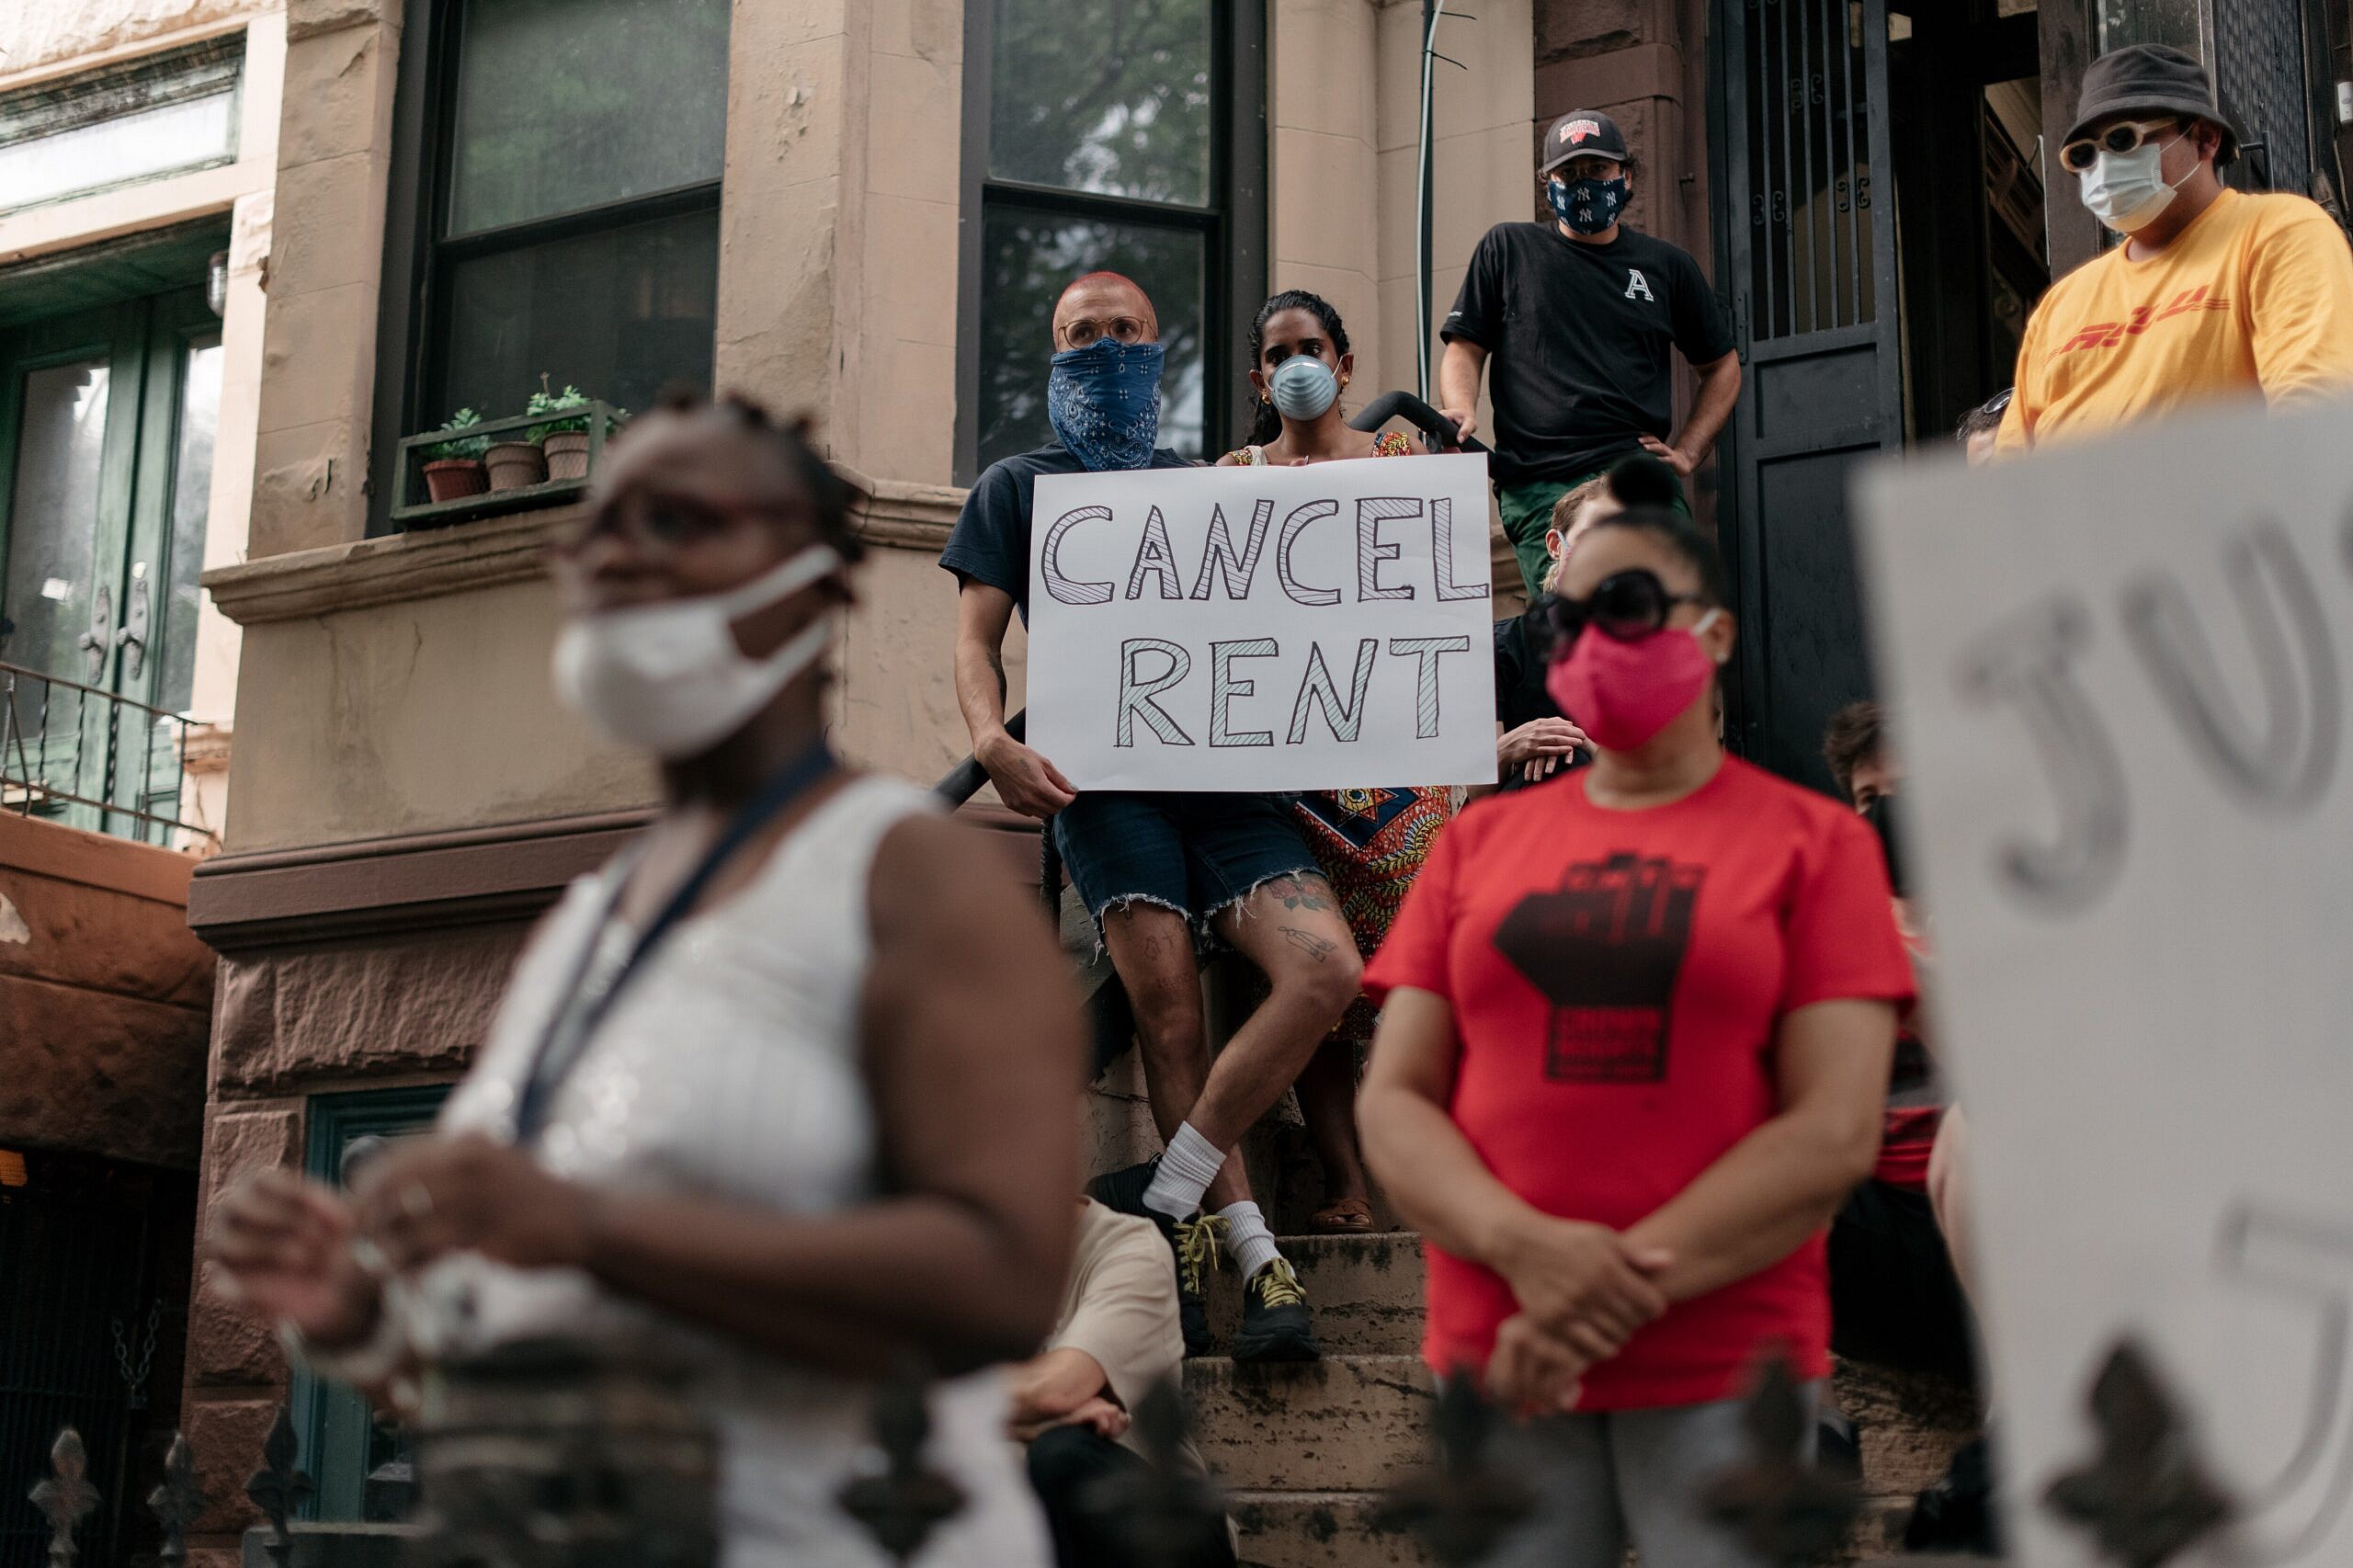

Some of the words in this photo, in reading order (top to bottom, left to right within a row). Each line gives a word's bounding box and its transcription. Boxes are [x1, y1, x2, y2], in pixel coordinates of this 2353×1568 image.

[1624, 268, 1654, 302] A
[1040, 497, 1490, 606] CANCEL
[1113, 635, 1471, 748] RENT
[1950, 492, 2353, 919] JU
